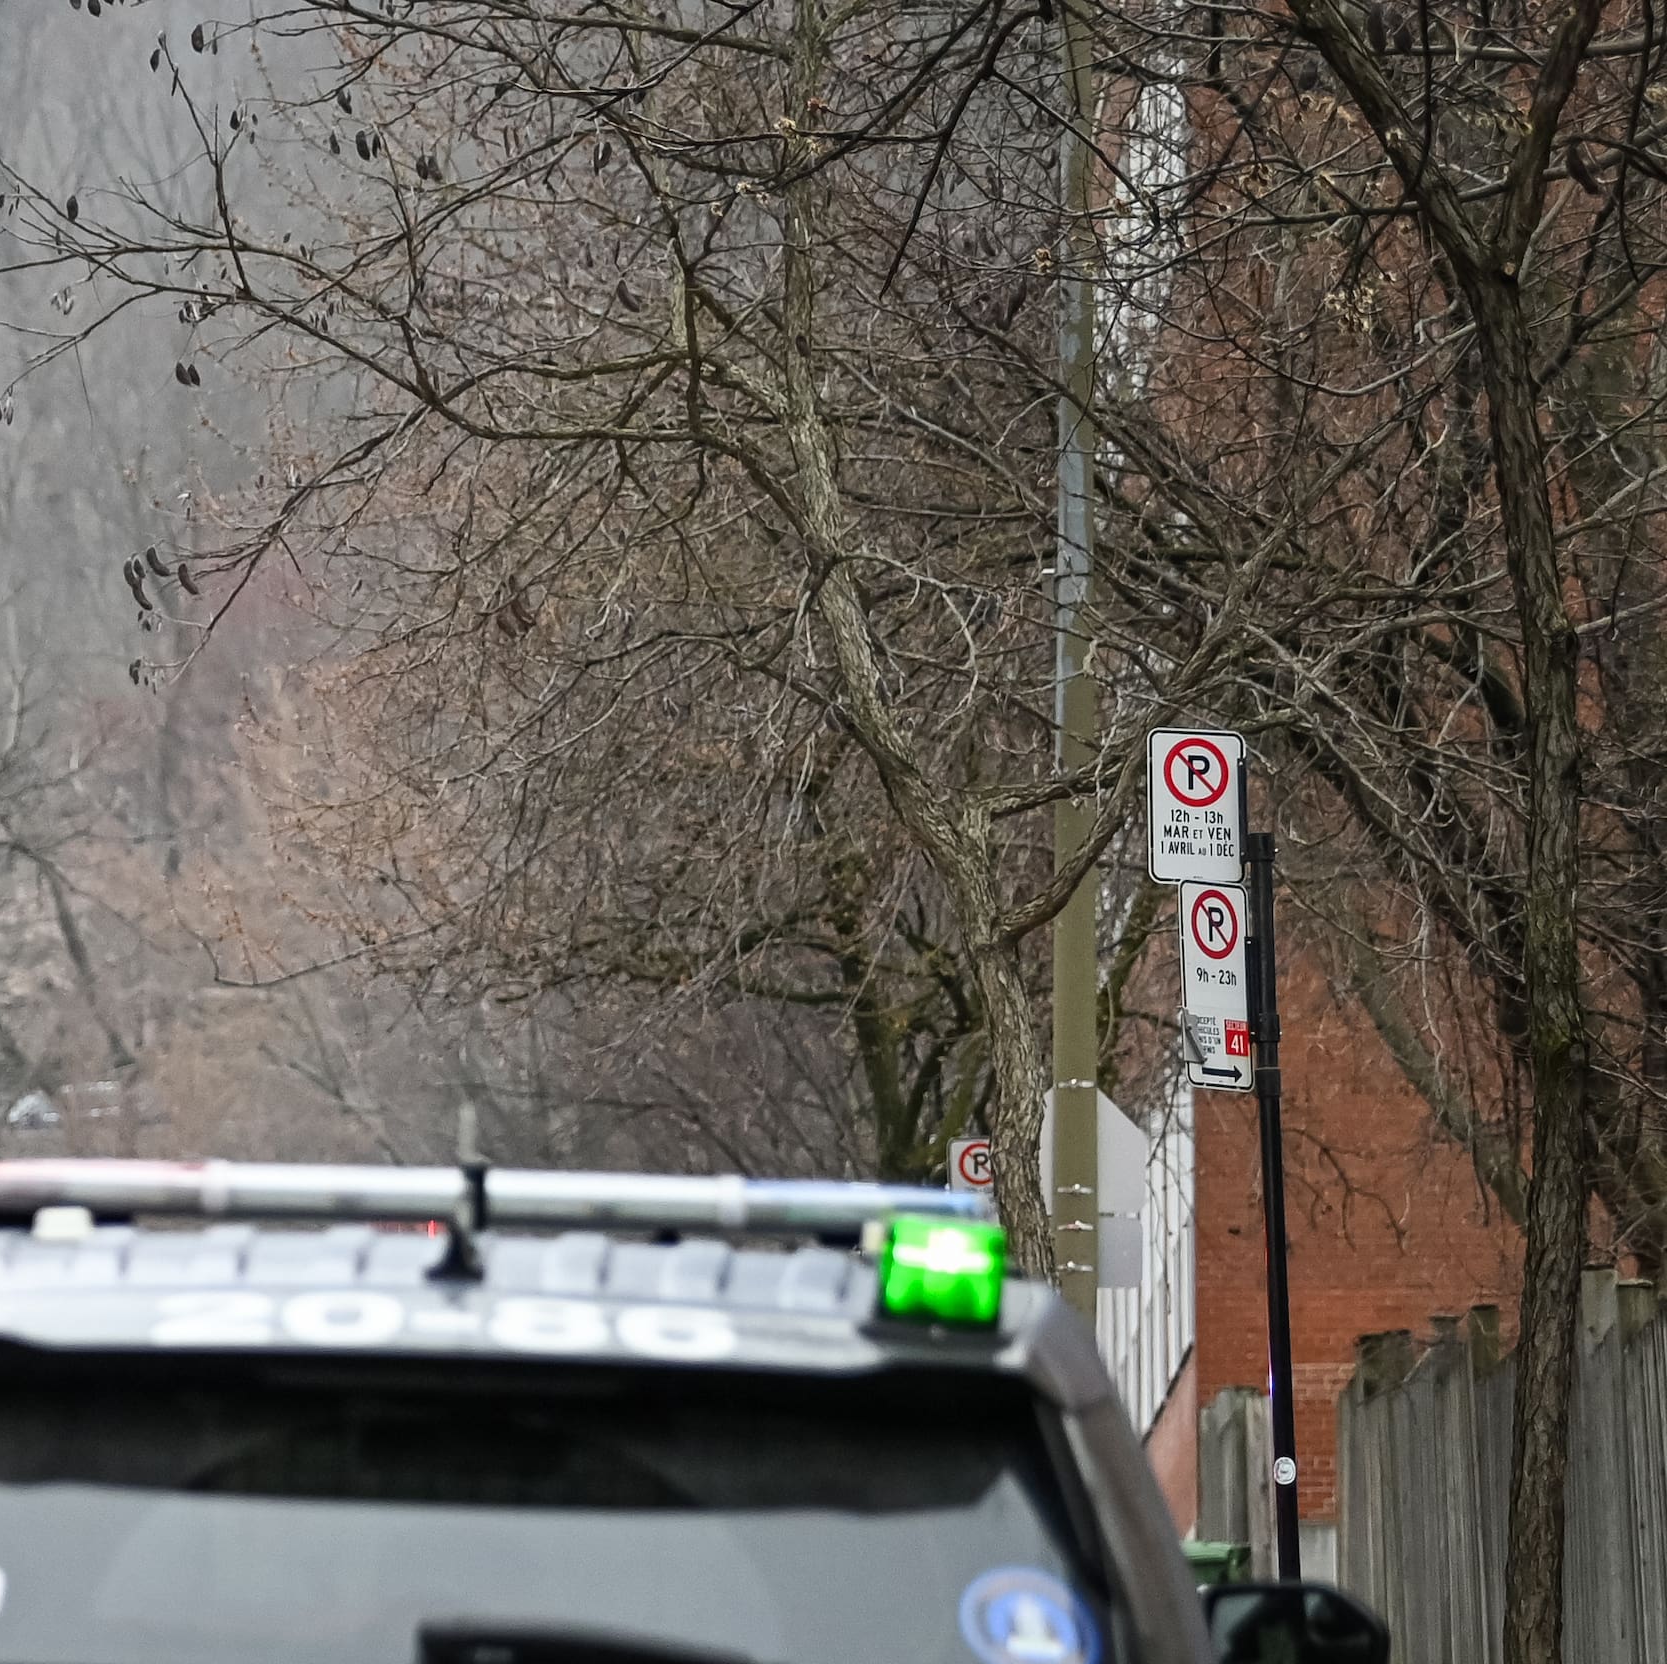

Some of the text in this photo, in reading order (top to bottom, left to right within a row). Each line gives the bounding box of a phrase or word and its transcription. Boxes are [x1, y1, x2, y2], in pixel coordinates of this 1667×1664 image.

[1188, 755, 1211, 790] P
[1171, 809, 1190, 823] 12h
[1205, 811, 1223, 824] 13h
[1164, 825, 1231, 840] MAR ET VEN
[1168, 841, 1195, 855] AVRIL
[1198, 848, 1207, 856] AU
[1218, 840, 1234, 857] DÉC
[1208, 906, 1224, 942] P
[1196, 967, 1209, 983] 9h
[1219, 970, 1237, 986] 23h
[1231, 1034, 1244, 1054] 41
